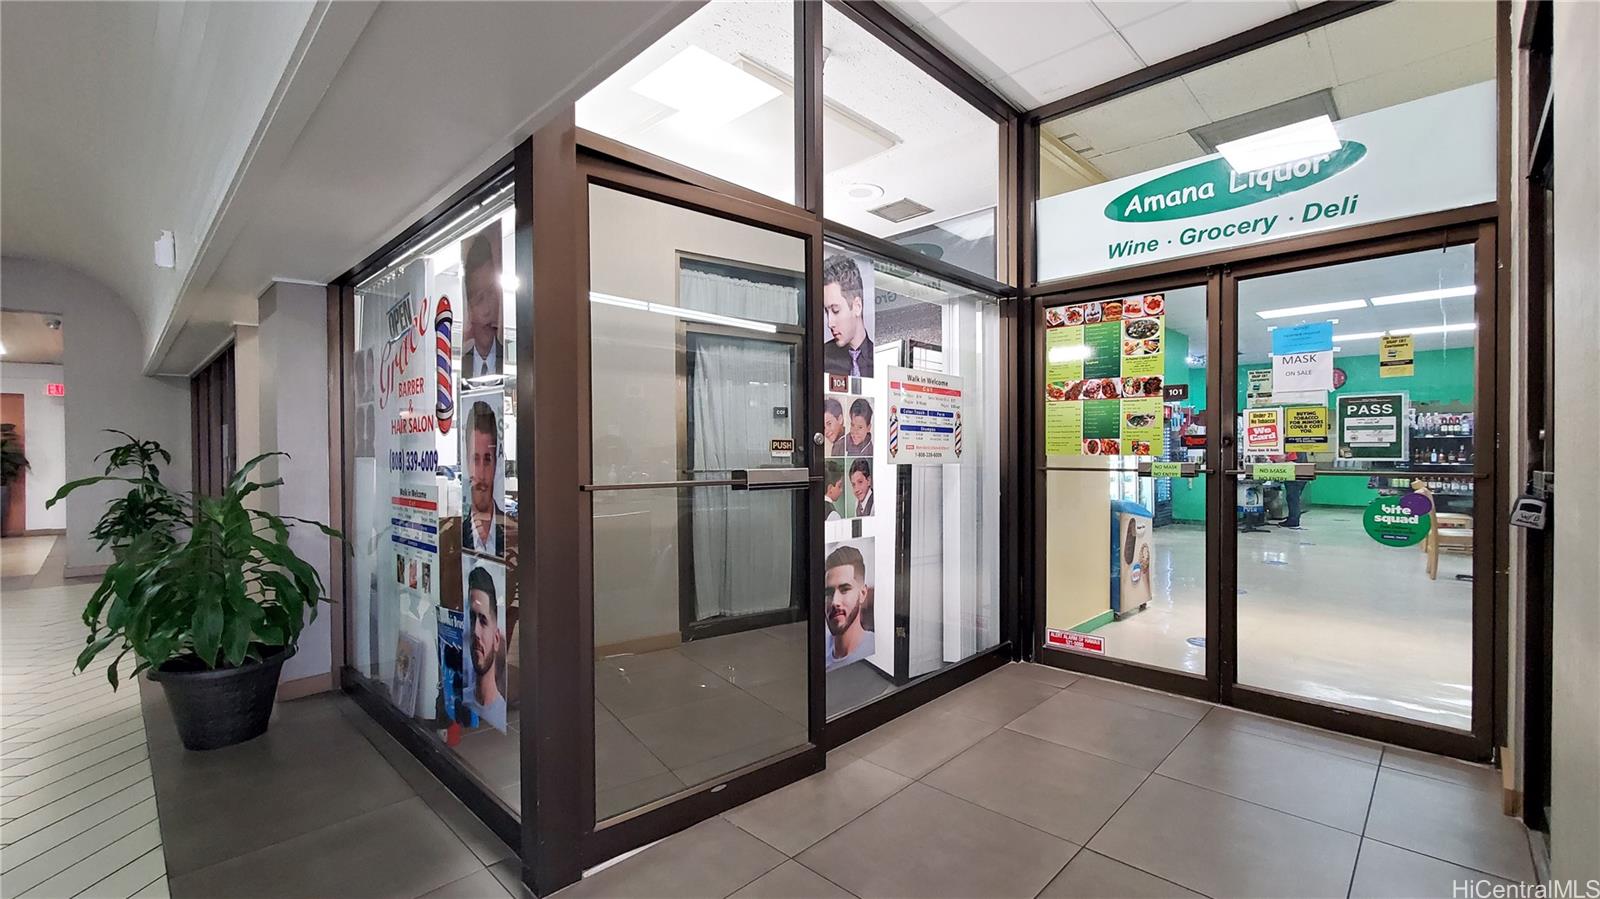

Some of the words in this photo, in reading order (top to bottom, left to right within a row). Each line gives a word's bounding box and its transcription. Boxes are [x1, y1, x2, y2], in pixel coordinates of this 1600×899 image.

[1124, 182, 1215, 217] Amana
[1228, 153, 1331, 194] Liquor
[1108, 239, 1159, 260] Wine
[1179, 215, 1279, 246] Grocery
[1302, 195, 1359, 223] Deli
[388, 298, 412, 337] OPEN
[1282, 354, 1317, 365] MASK
[833, 379, 846, 387] 104
[907, 374, 920, 382] Walk
[927, 378, 949, 387] Welcome
[398, 377, 425, 398] BARBER
[1168, 389, 1184, 397] 101
[408, 399, 414, 413] &
[1347, 403, 1394, 416] PASS
[391, 418, 407, 435] HAIR
[408, 415, 435, 434] SALON
[1253, 427, 1272, 435] We
[1249, 432, 1277, 441] Card
[772, 441, 792, 449] PUSH
[389, 448, 405, 473] (808)
[405, 450, 439, 472] 339-6009
[1381, 504, 1412, 515] bite
[1374, 514, 1419, 525] squad
